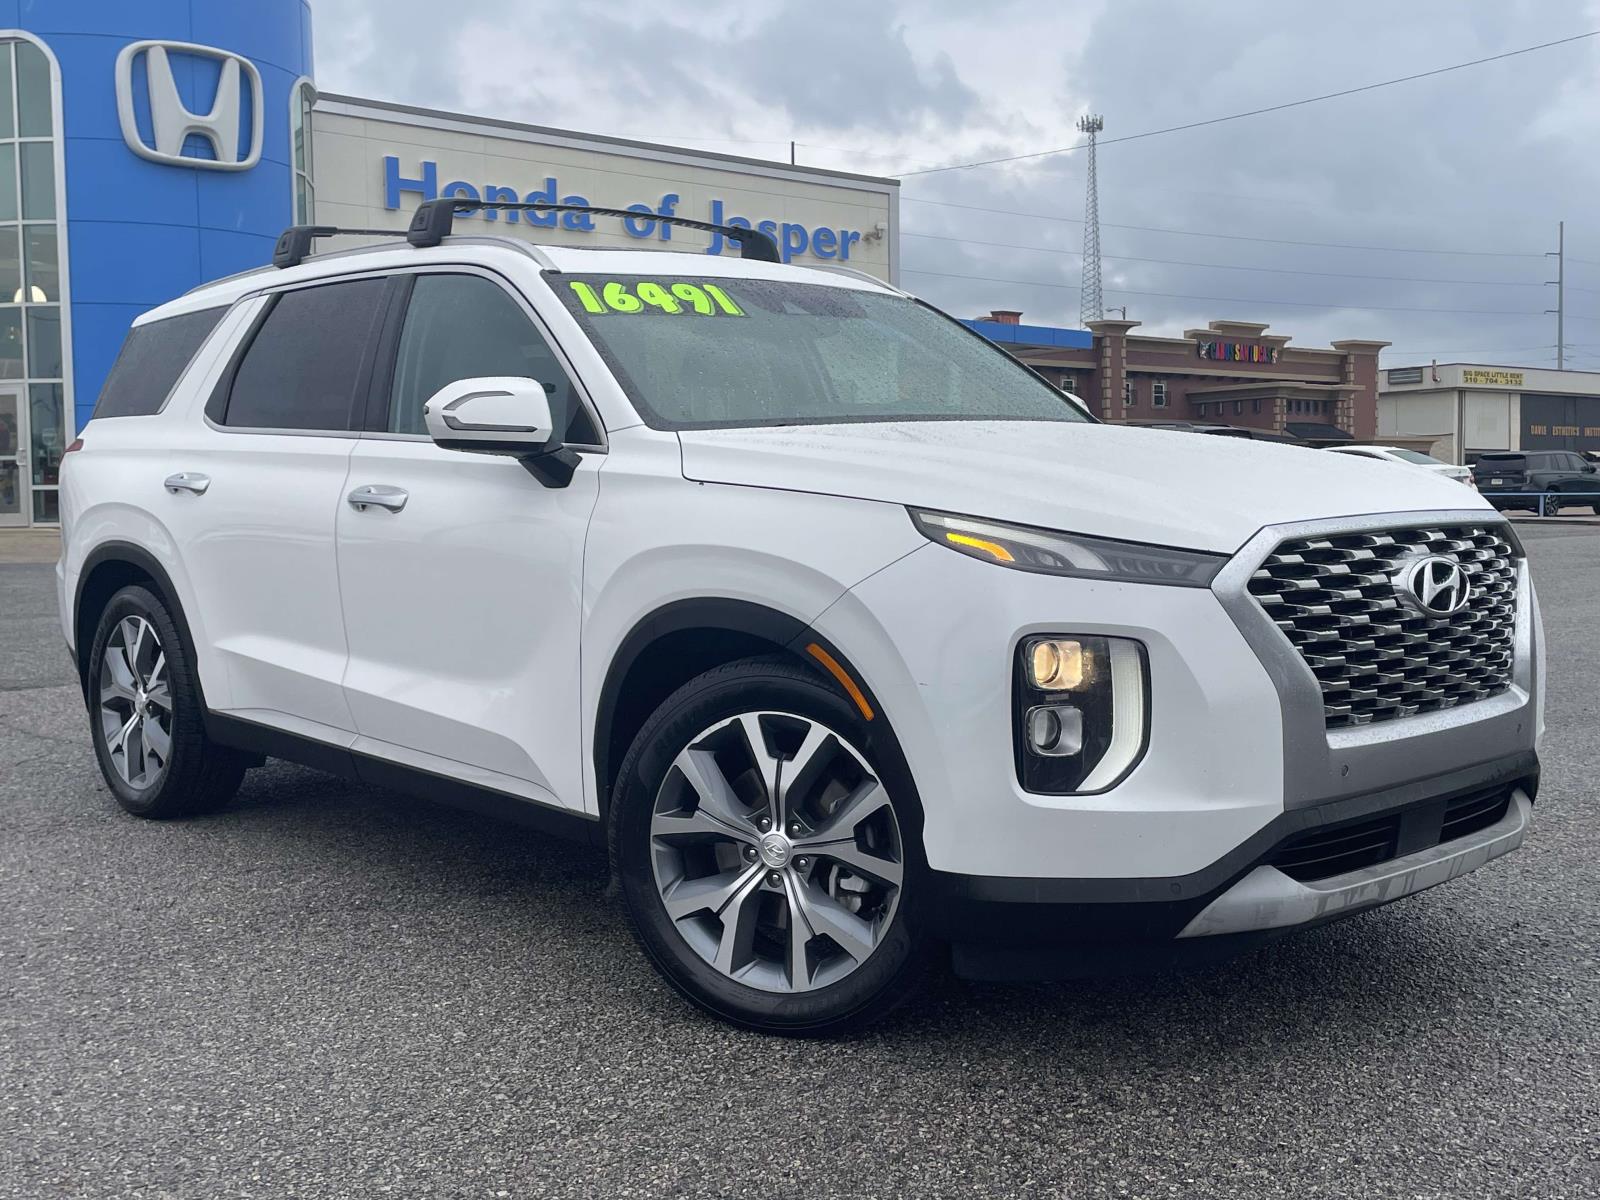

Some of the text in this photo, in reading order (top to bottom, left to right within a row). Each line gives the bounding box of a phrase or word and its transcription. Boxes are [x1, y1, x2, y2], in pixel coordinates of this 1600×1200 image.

[384, 155, 861, 264] Honda of Jasper
[569, 281, 746, 317] 16491
[1485, 377, 1498, 385] 704
[1491, 371, 1508, 379] LITTLE
